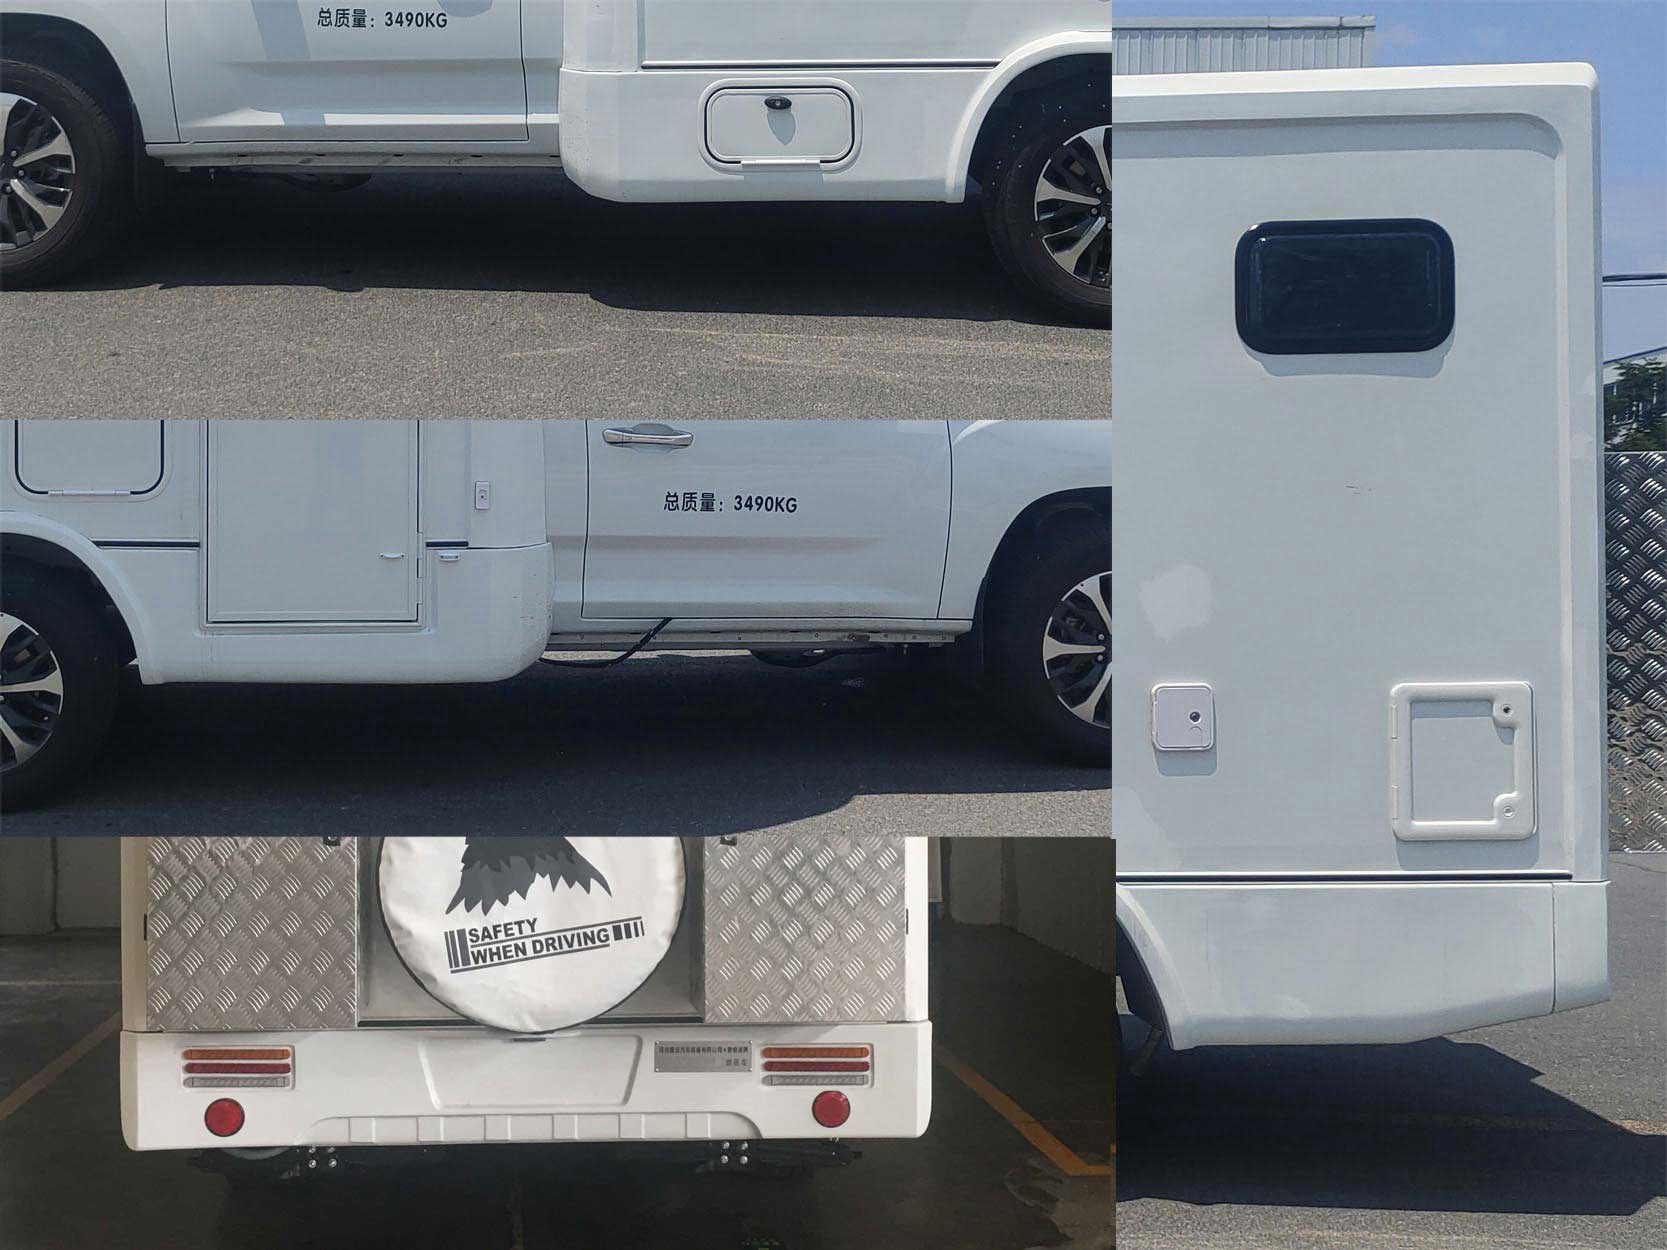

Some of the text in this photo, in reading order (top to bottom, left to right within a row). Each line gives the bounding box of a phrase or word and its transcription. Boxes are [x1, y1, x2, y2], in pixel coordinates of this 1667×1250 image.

[468, 917, 538, 943] SAFETY
[470, 928, 611, 965] WHEN DRIVING
